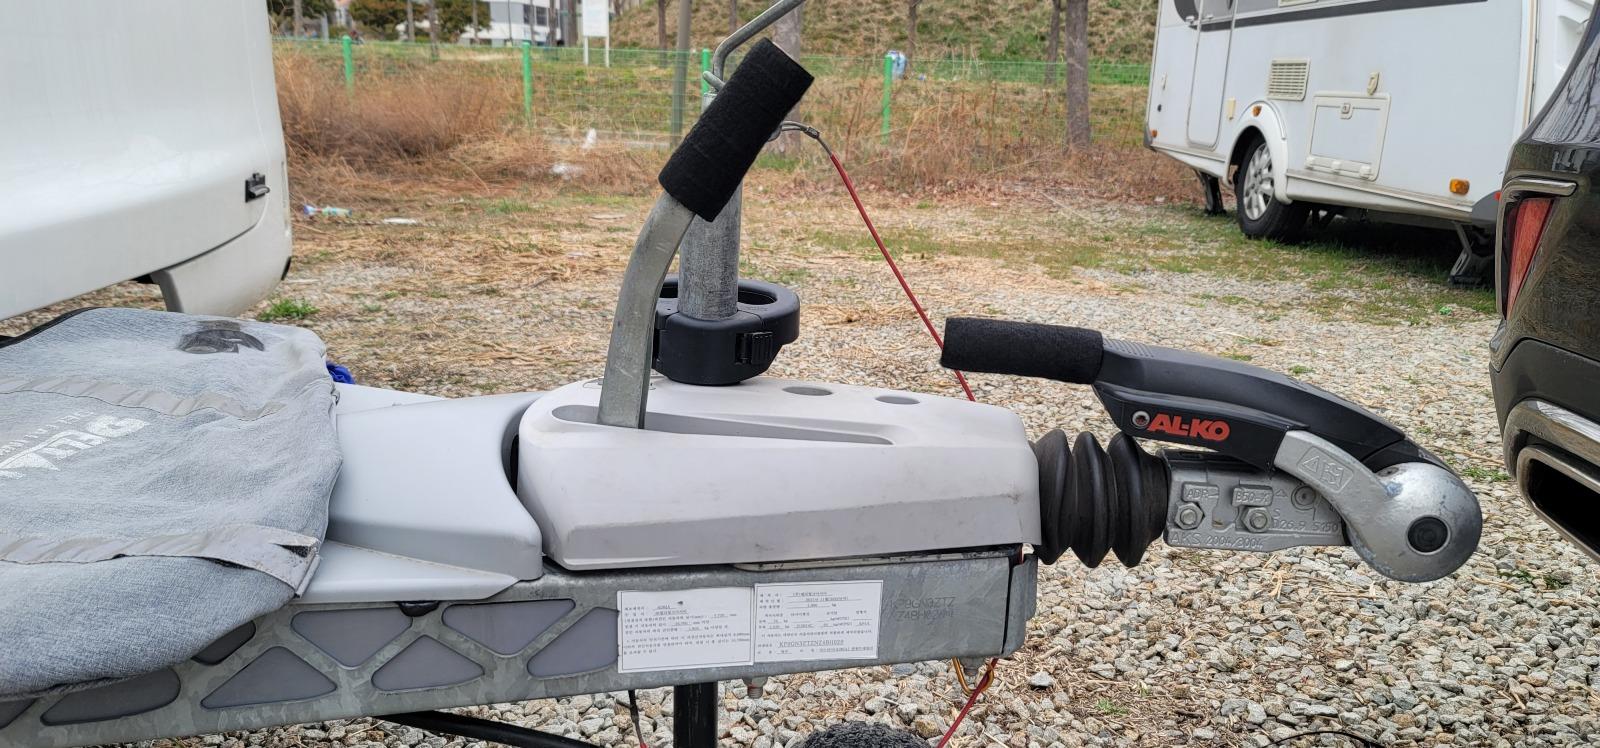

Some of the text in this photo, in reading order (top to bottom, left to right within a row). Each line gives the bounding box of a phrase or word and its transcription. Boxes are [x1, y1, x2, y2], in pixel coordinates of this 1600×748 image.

[1147, 413, 1230, 441] AL-KO
[1170, 532, 1264, 549] AKS 2004/3004
